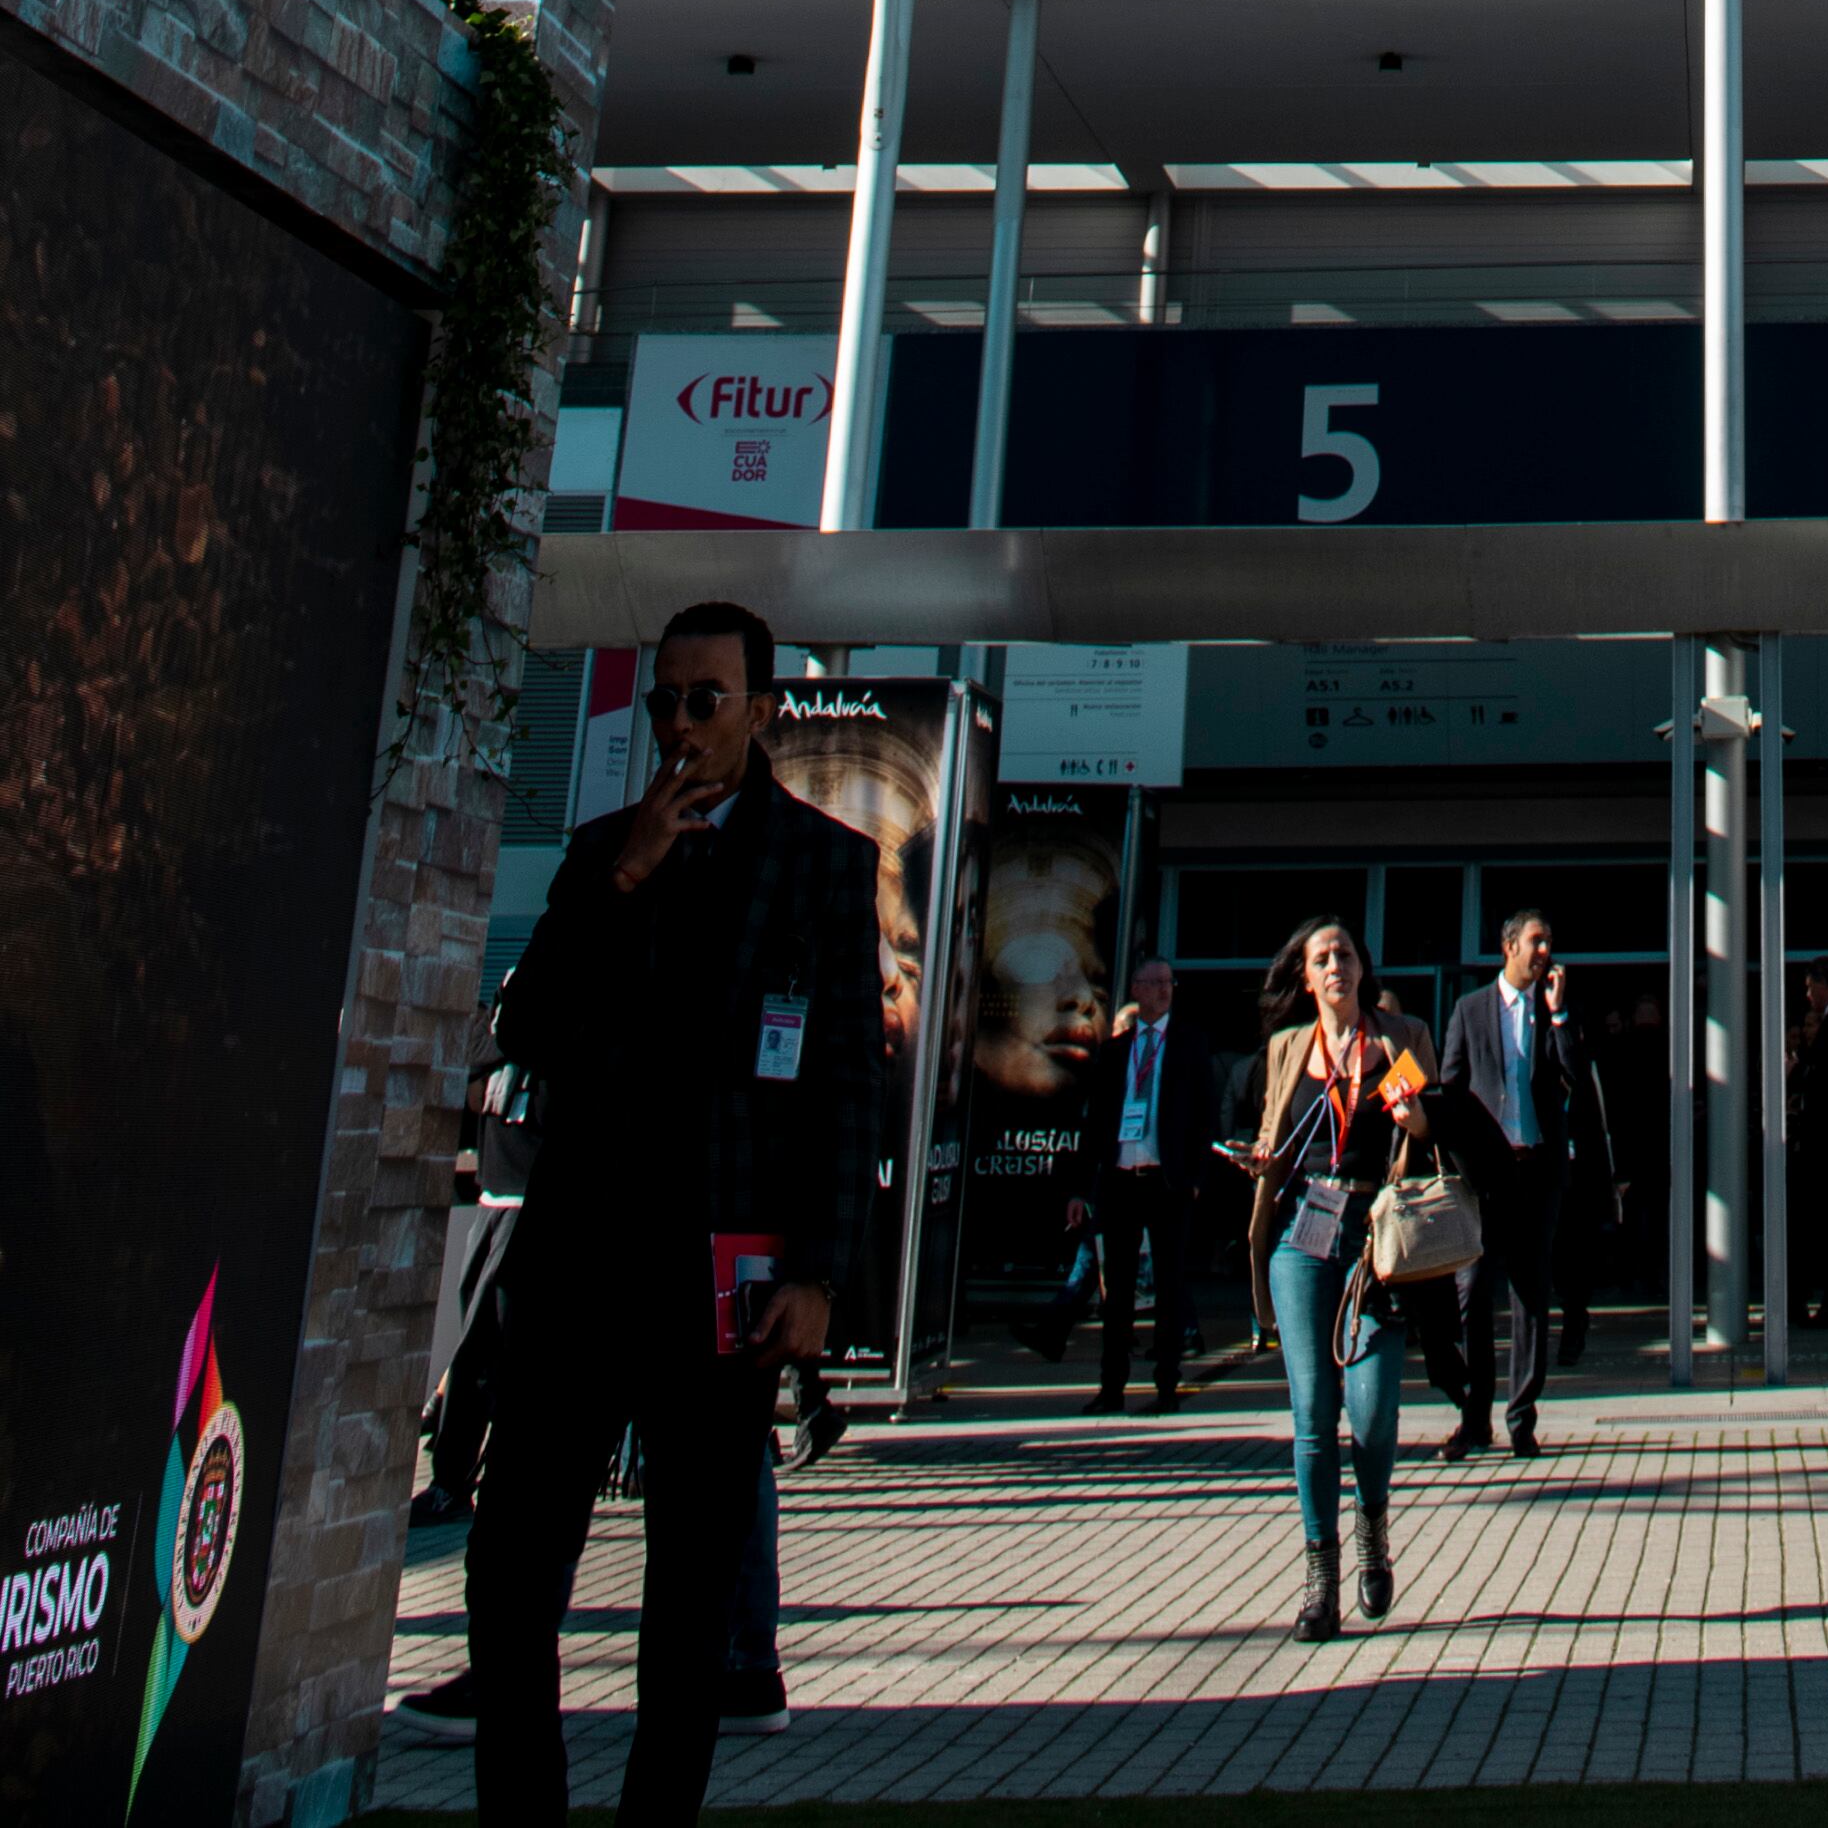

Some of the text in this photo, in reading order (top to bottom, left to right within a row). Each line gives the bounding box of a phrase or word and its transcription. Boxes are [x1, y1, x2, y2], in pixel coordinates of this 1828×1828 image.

[709, 375, 815, 419] Fitur
[731, 469, 768, 482] DOR
[1297, 382, 1382, 524] 5
[24, 1501, 122, 1560] COMPAÑÍA DE
[5, 1635, 101, 1701] PUERTO RICO
